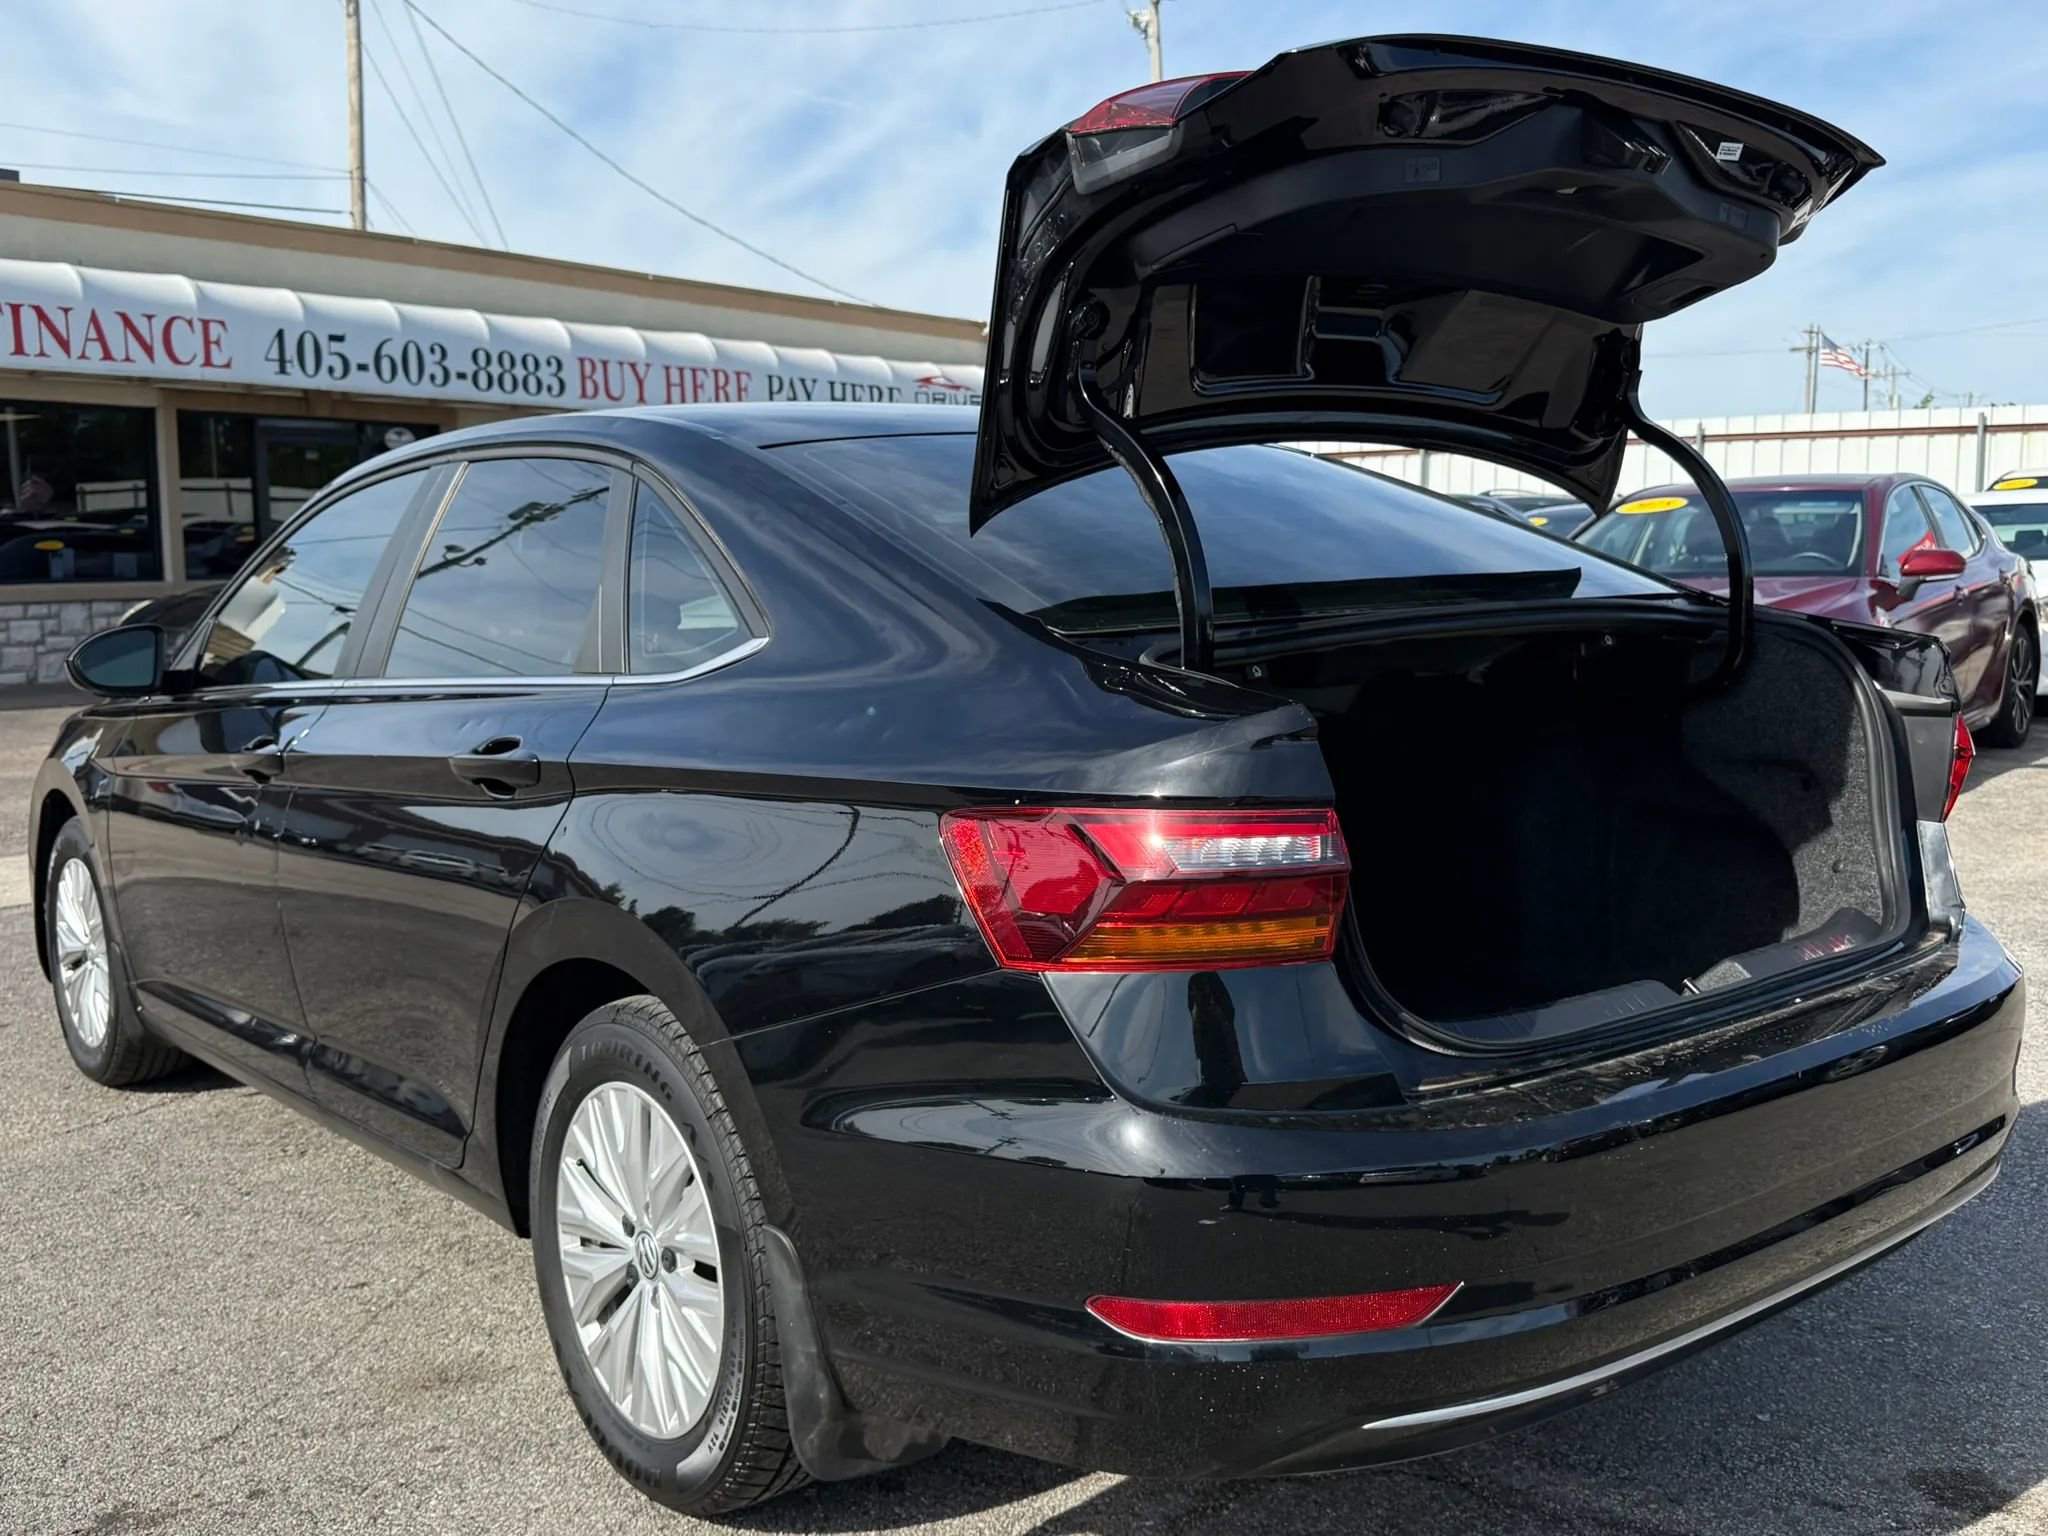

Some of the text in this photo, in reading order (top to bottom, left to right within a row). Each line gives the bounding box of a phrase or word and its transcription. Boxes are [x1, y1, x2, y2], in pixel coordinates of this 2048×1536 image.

[0, 302, 232, 369] INANCE
[264, 328, 566, 398] 405-603-8883
[577, 356, 652, 404] BUY
[766, 374, 817, 403] PAY
